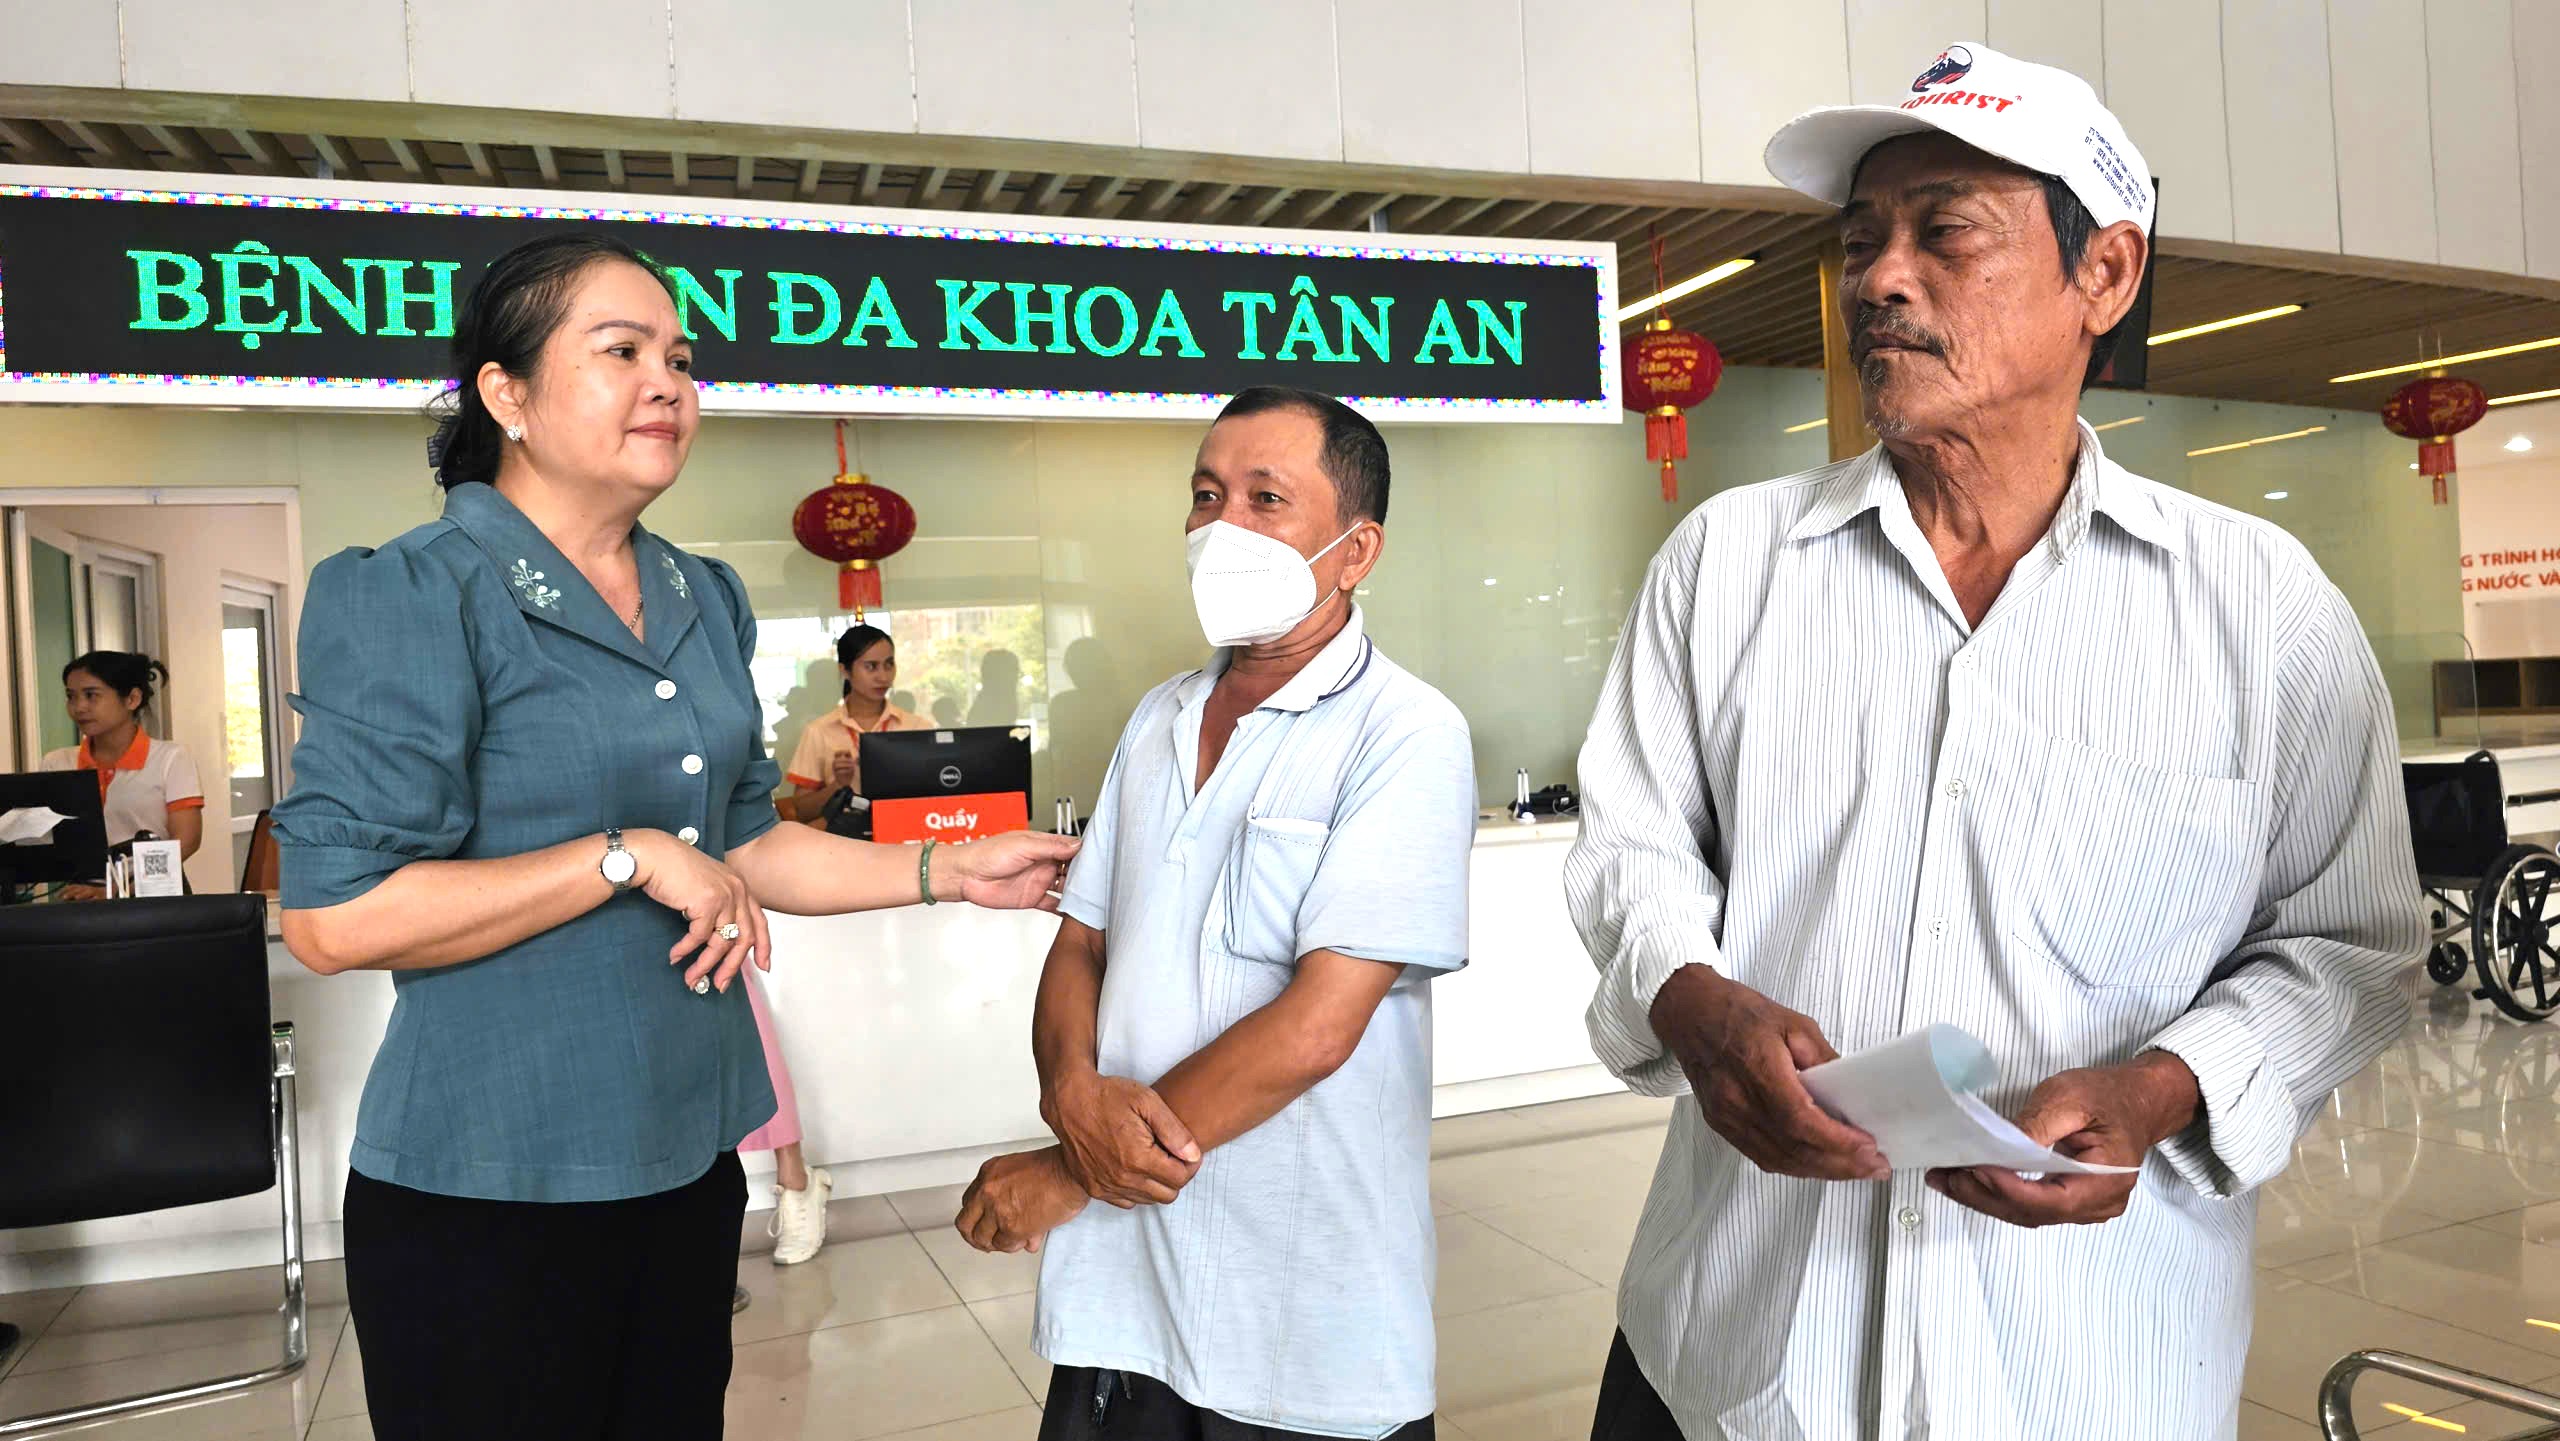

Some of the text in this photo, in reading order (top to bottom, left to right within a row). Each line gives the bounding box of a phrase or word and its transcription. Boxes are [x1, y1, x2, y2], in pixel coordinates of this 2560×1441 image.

[126, 241, 461, 349] BỆNH
[768, 272, 918, 348] ĐA
[936, 280, 1206, 357] KHOA
[1223, 276, 1394, 362] TÂN
[1414, 299, 1528, 365] AN
